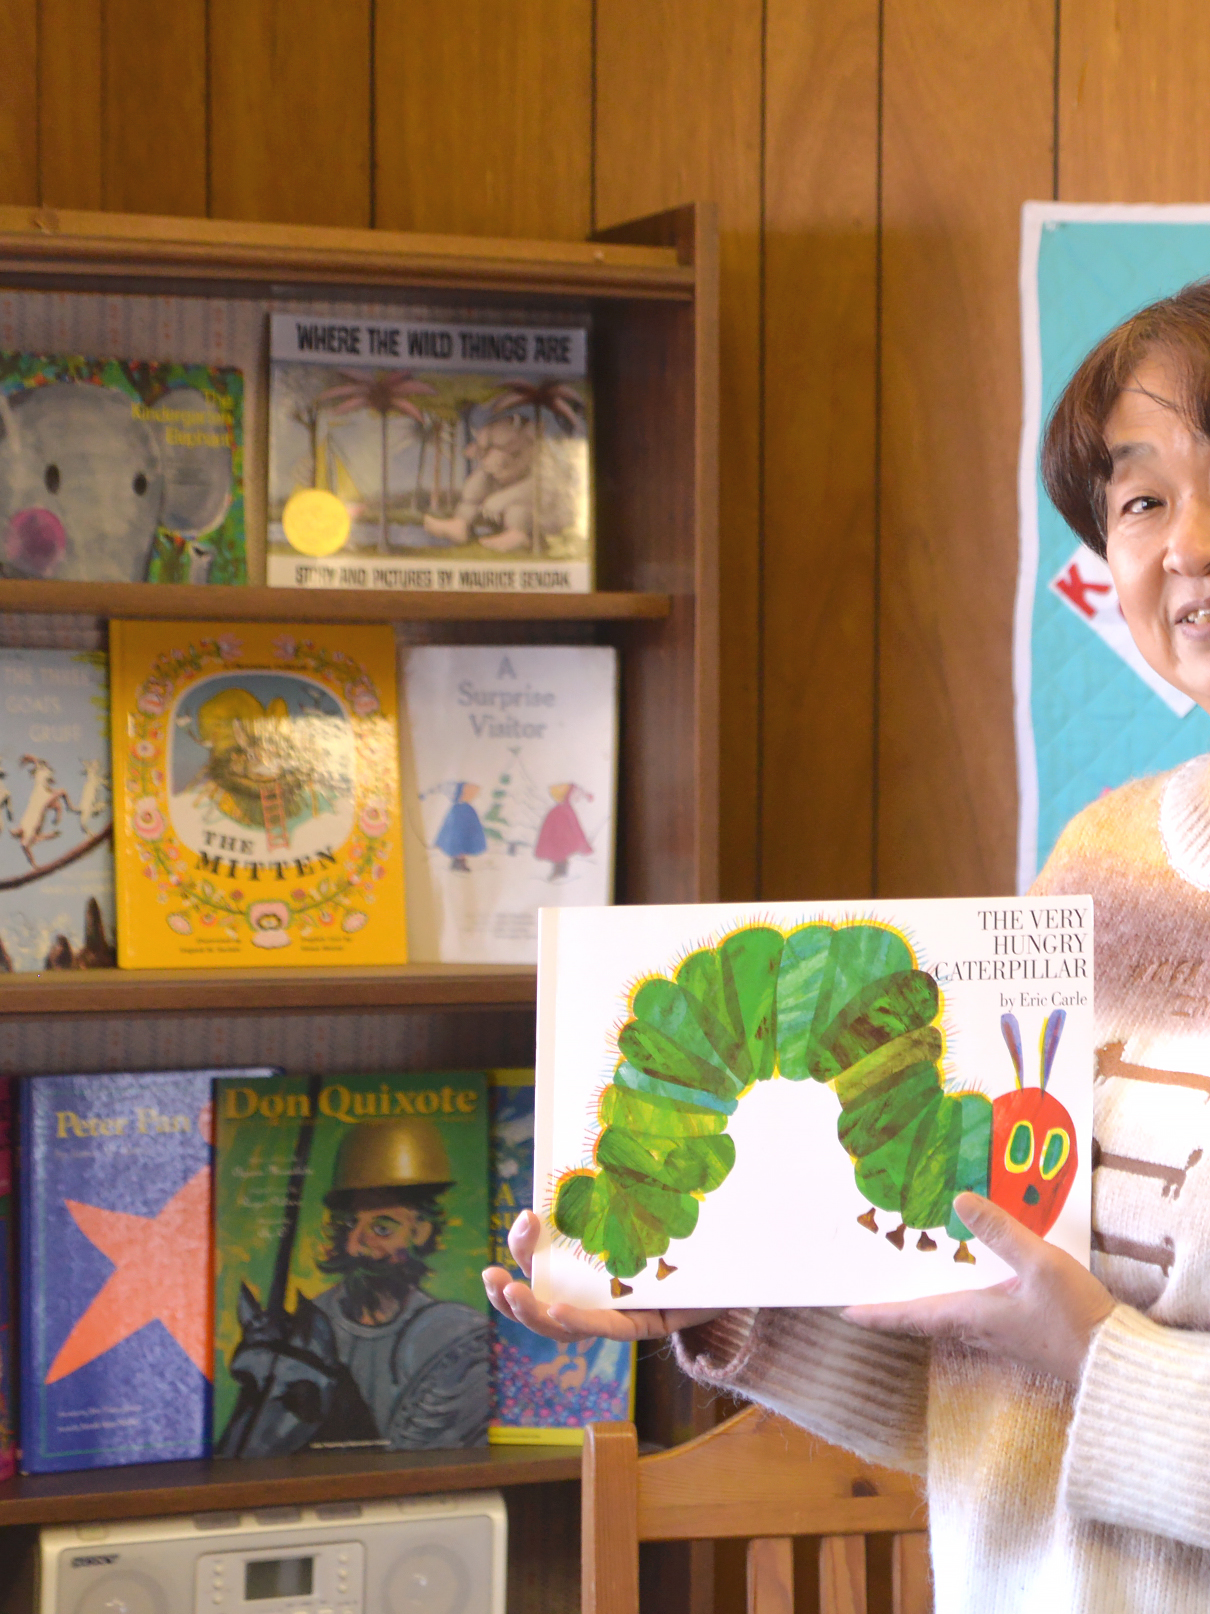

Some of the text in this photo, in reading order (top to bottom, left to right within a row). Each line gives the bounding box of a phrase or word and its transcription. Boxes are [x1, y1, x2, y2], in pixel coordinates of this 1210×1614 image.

[296, 323, 571, 364] WHERE THE WILD THINGS ARE
[339, 567, 366, 586] AND
[372, 568, 432, 587] PICTURES
[436, 570, 453, 587] BY
[458, 570, 515, 588] MAURICE
[1056, 563, 1111, 619] K
[498, 655, 516, 679] A
[457, 679, 556, 711] Surprise
[469, 713, 547, 739] Visitor
[203, 830, 253, 854] THE
[194, 845, 337, 881] MITTEN
[977, 908, 1088, 931] THE VERY
[993, 934, 1088, 955] HUNGRY
[935, 958, 1088, 981] CATERPILLAR
[1000, 991, 1088, 1012] by Eric Carle
[225, 1083, 478, 1123] Don Quixote
[56, 1107, 191, 1138] Peter Pan
